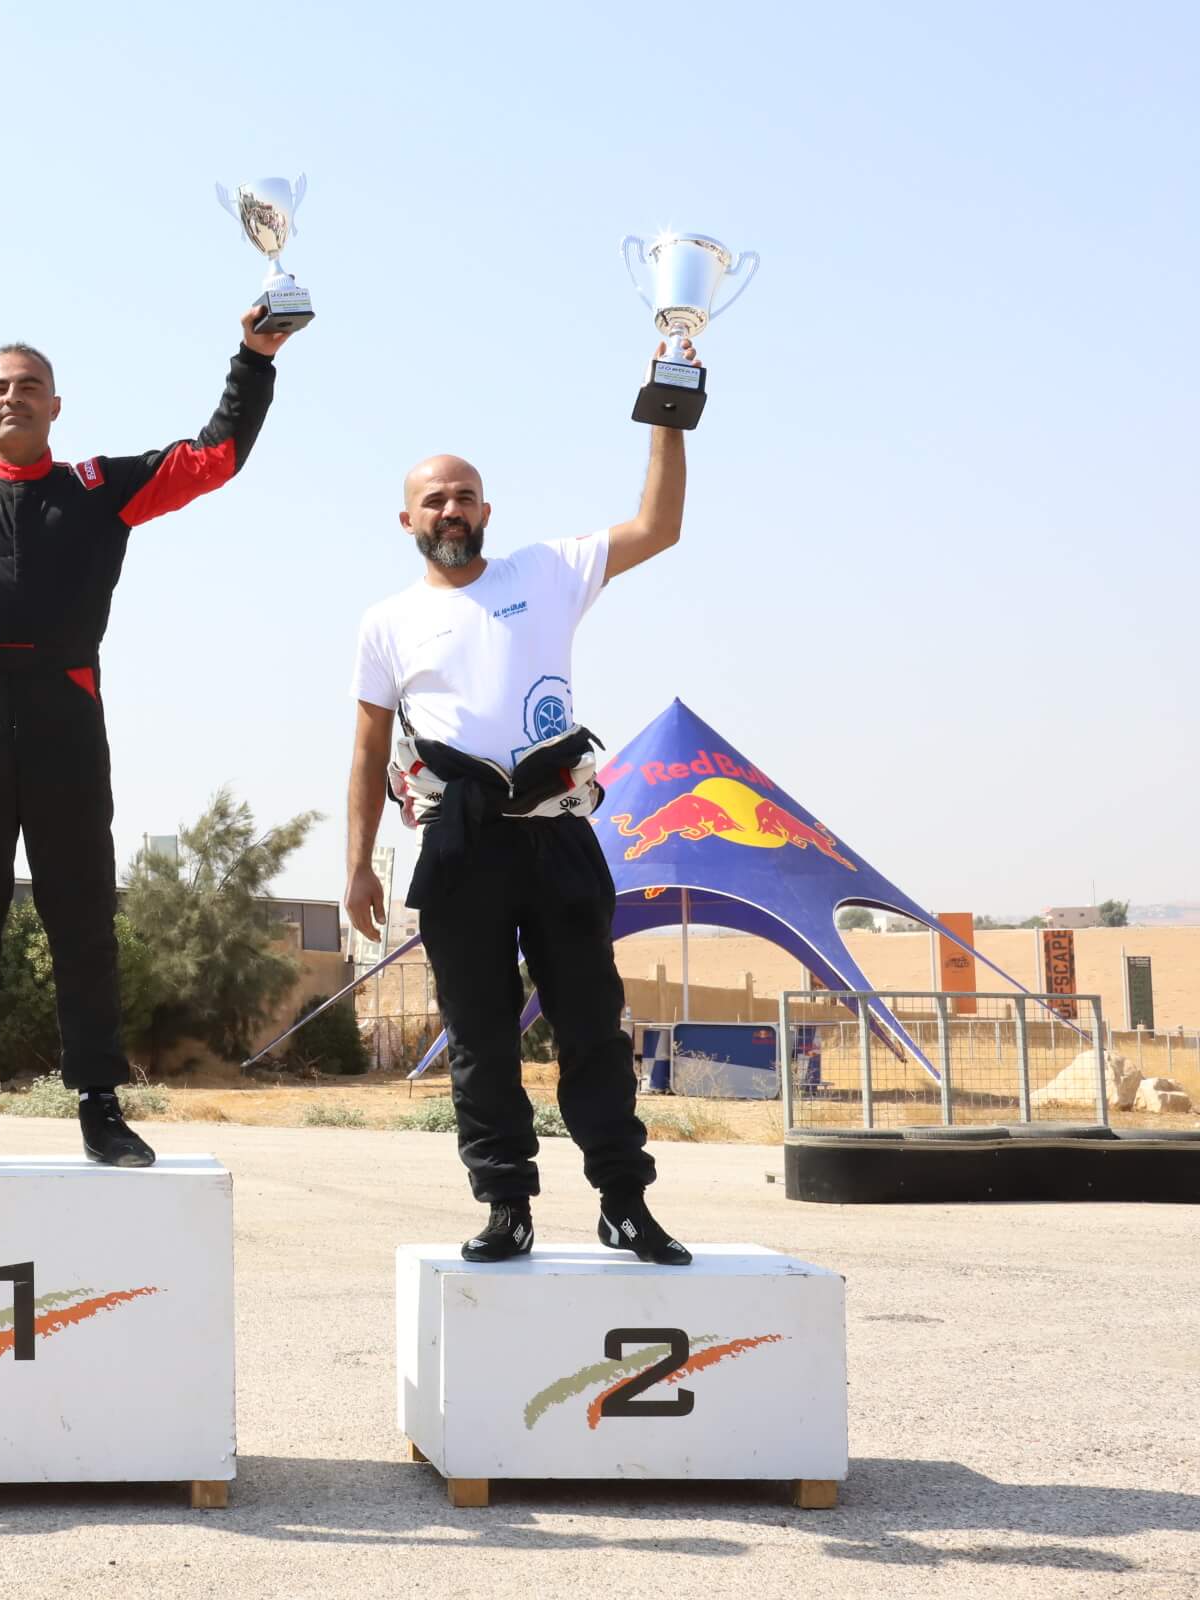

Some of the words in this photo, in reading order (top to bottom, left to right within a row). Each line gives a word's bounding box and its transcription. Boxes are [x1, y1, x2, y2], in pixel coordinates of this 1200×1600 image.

[640, 750, 716, 785] Red
[712, 752, 776, 791] Bull
[620, 1218, 638, 1241] OMP
[601, 1328, 695, 1417] 2
